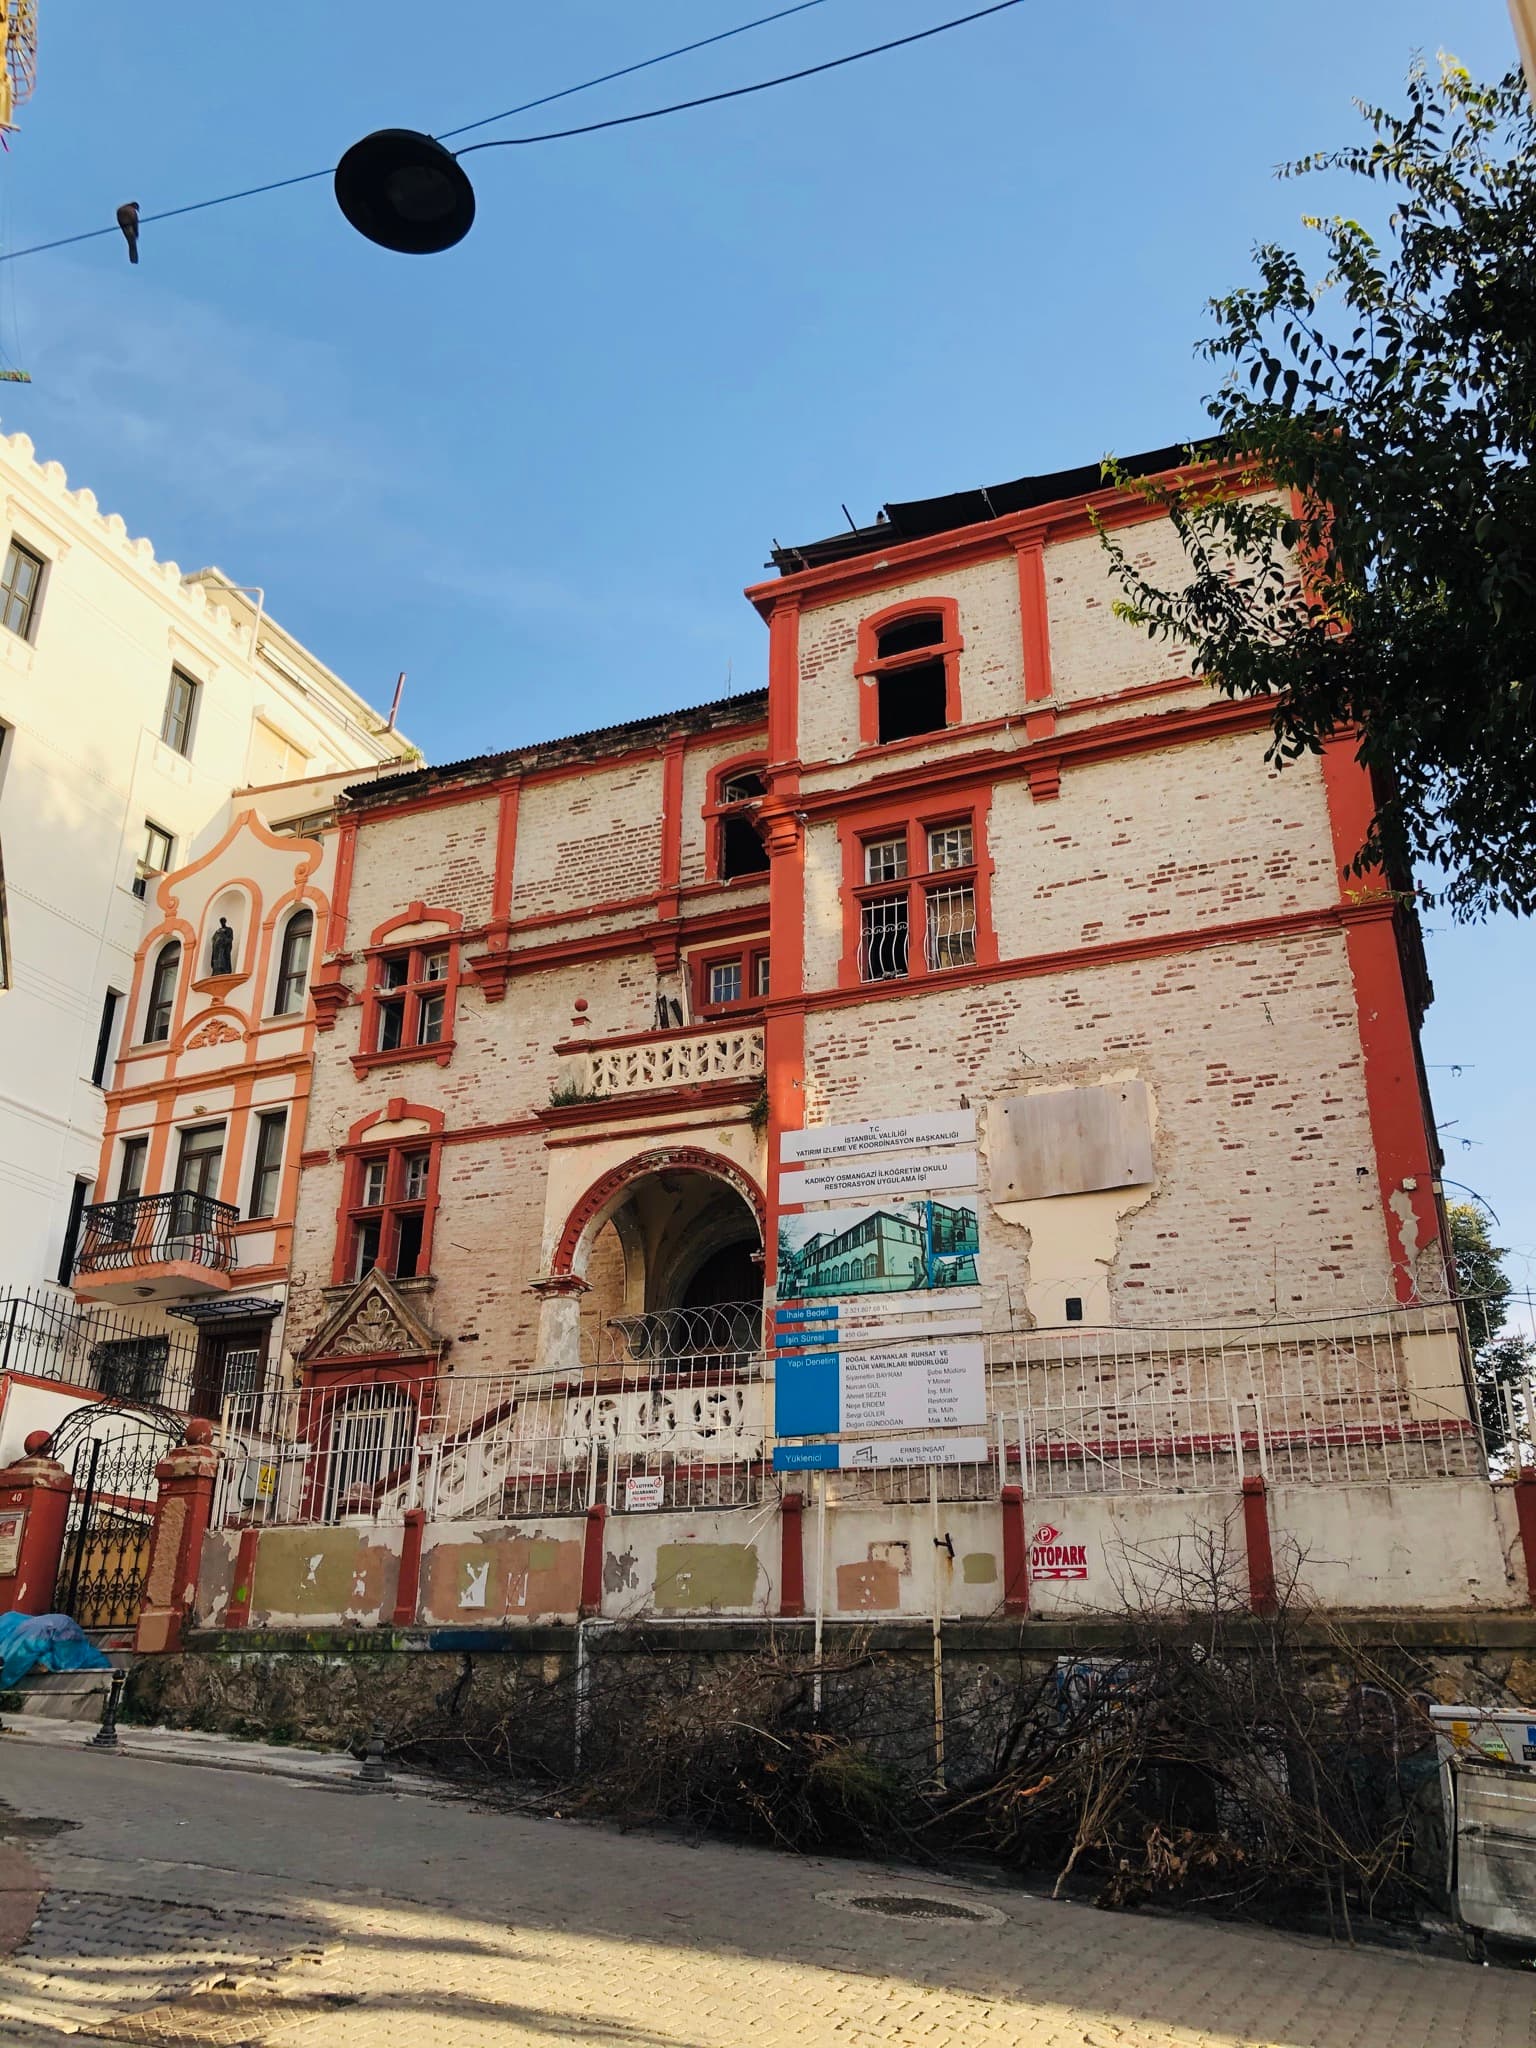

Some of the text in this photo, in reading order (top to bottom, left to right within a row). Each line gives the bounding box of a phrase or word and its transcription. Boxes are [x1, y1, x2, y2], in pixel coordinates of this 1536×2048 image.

[844, 1133, 878, 1144] İSTANBUL
[796, 1148, 822, 1157] YATIRIM
[823, 1144, 847, 1154] İZLEME
[848, 1143, 858, 1151] VE
[859, 1137, 914, 1150] KOORDİNASYON
[836, 1170, 877, 1181] OSMANGAZİ
[878, 1165, 921, 1177] İLKÖĞRETİM
[922, 1163, 948, 1173] OKULU
[824, 1179, 876, 1191] RESTORASYON
[877, 1175, 916, 1186] UYGULAMA
[806, 1308, 829, 1318] Bedeli
[870, 1352, 908, 1361] KAYNAKLAR
[911, 1350, 936, 1358] RUHSAT
[805, 1357, 836, 1367] Denetim
[845, 1362, 870, 1371] KÜLTÜR
[871, 1361, 907, 1369] VARLIKLARI
[12, 1493, 22, 1502] 40
[1032, 1546, 1087, 1566] OTOPARK
